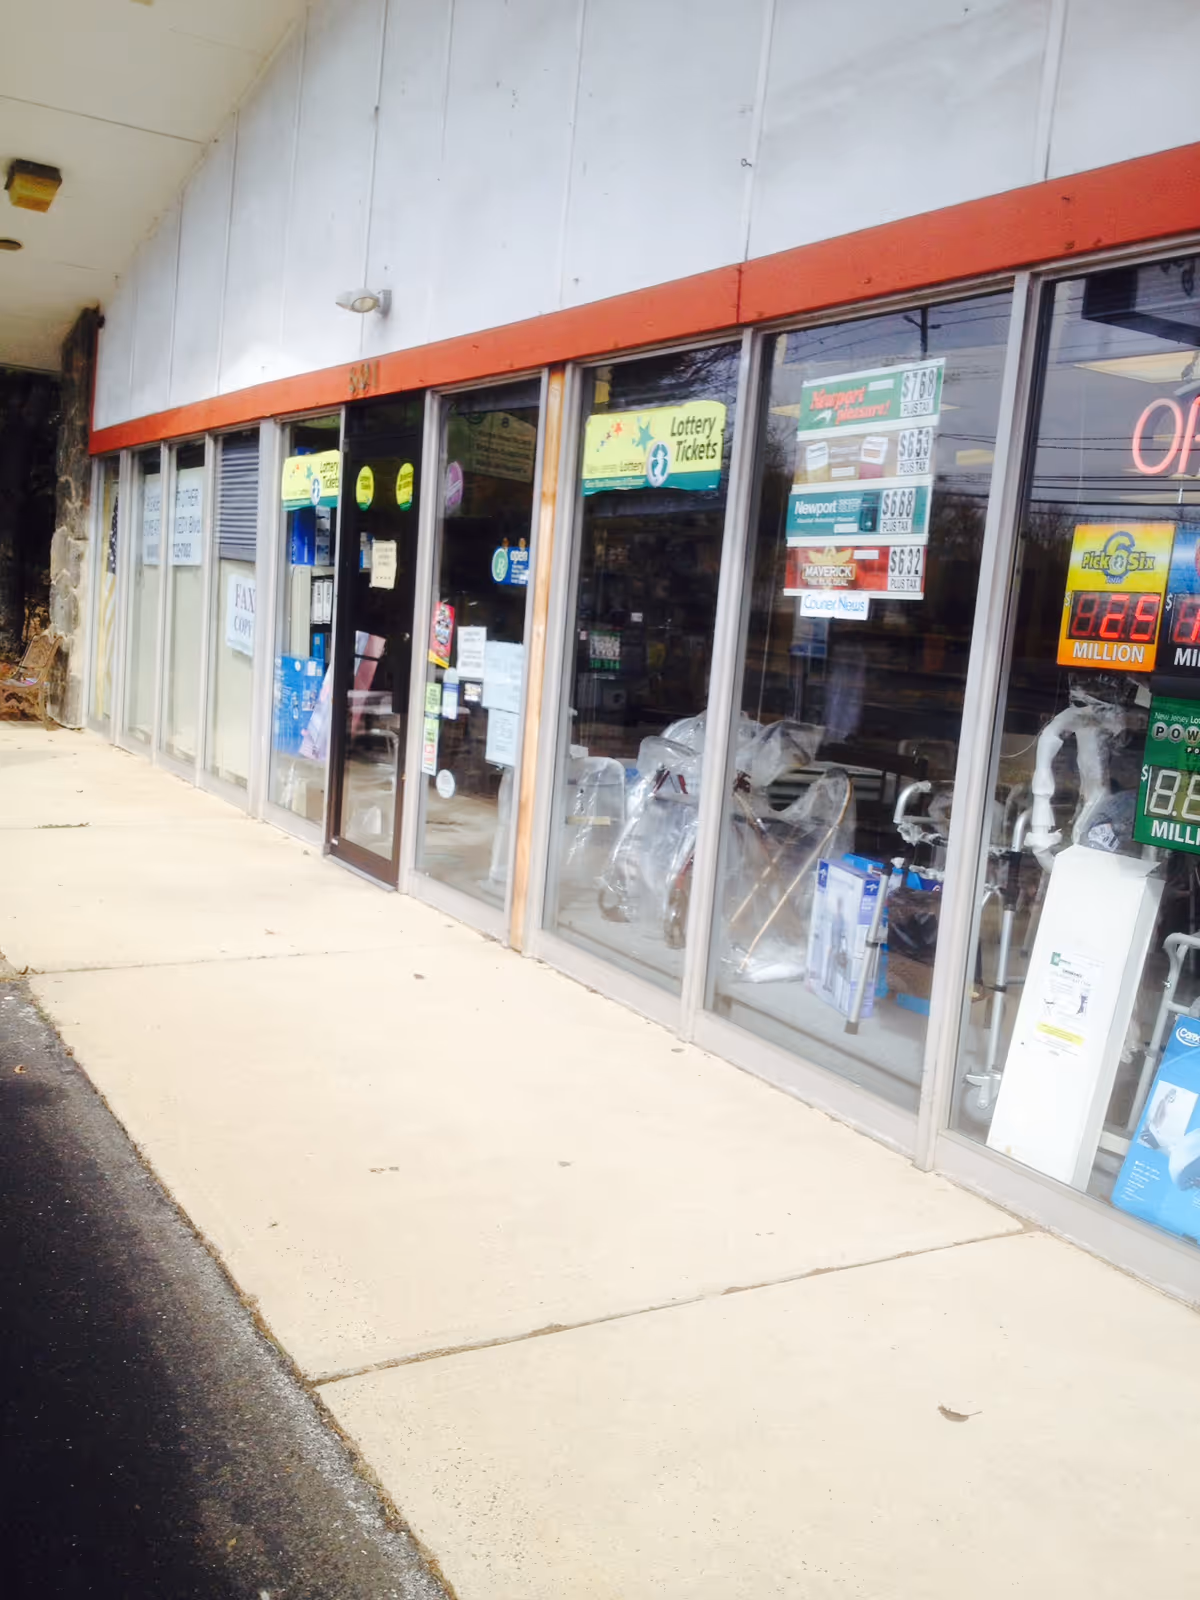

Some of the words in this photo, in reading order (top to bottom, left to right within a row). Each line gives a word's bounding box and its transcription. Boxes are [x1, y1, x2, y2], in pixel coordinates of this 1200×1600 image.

[903, 402, 918, 415] PLUS
[919, 400, 930, 412] TAX
[670, 416, 716, 439] Lottery
[675, 439, 718, 462] Tickets
[900, 462, 914, 473] PLUS
[916, 460, 926, 471] TAX
[794, 500, 837, 516] Newport
[883, 521, 897, 532] PLUS
[898, 520, 909, 531] TAX
[510, 550, 528, 564] open
[1081, 550, 1110, 571] Pick
[1127, 550, 1156, 572] Six
[805, 565, 852, 578] MAVERICK
[891, 578, 905, 590] PLUS
[906, 578, 917, 590] TAX
[235, 583, 256, 613] FAX
[838, 594, 865, 612] News
[1072, 641, 1145, 663] MILLION
[1174, 647, 1200, 668] MI
[1154, 711, 1169, 721] New
[1170, 714, 1189, 724] Jersey
